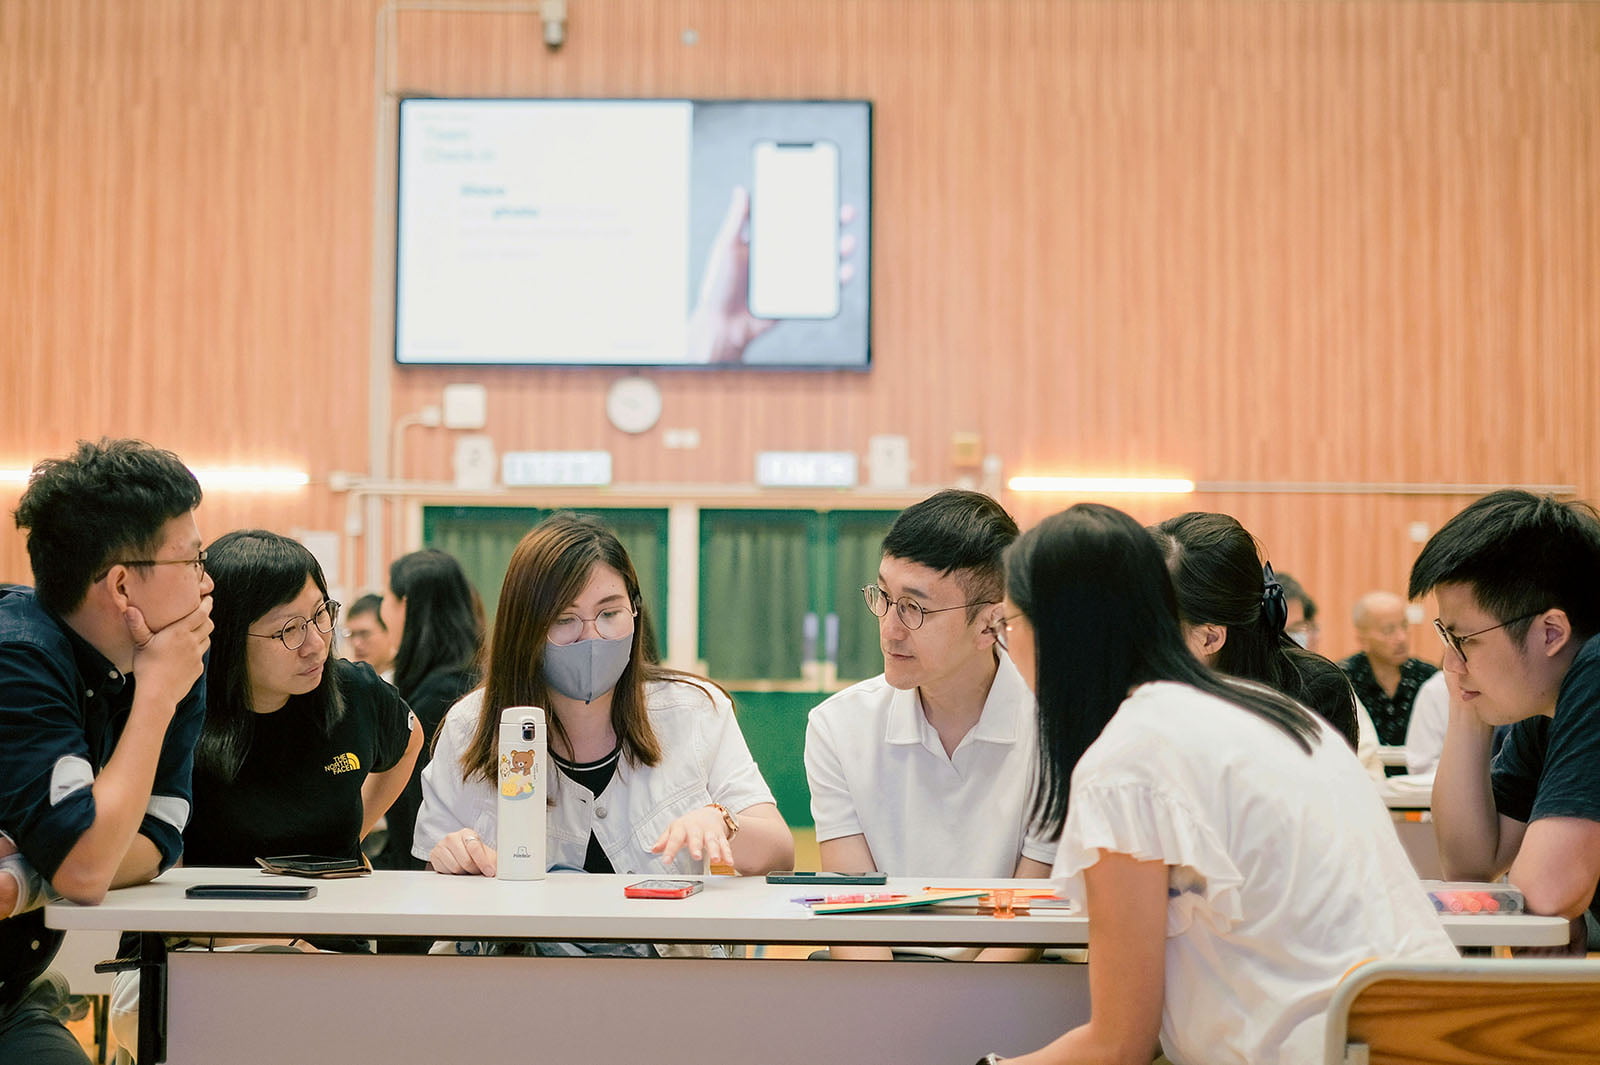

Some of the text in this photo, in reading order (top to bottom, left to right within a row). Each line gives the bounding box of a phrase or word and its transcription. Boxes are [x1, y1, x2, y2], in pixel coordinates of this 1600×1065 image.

[333, 753, 347, 763] THE
[324, 759, 349, 772] NORTH
[333, 765, 351, 775] FACE
